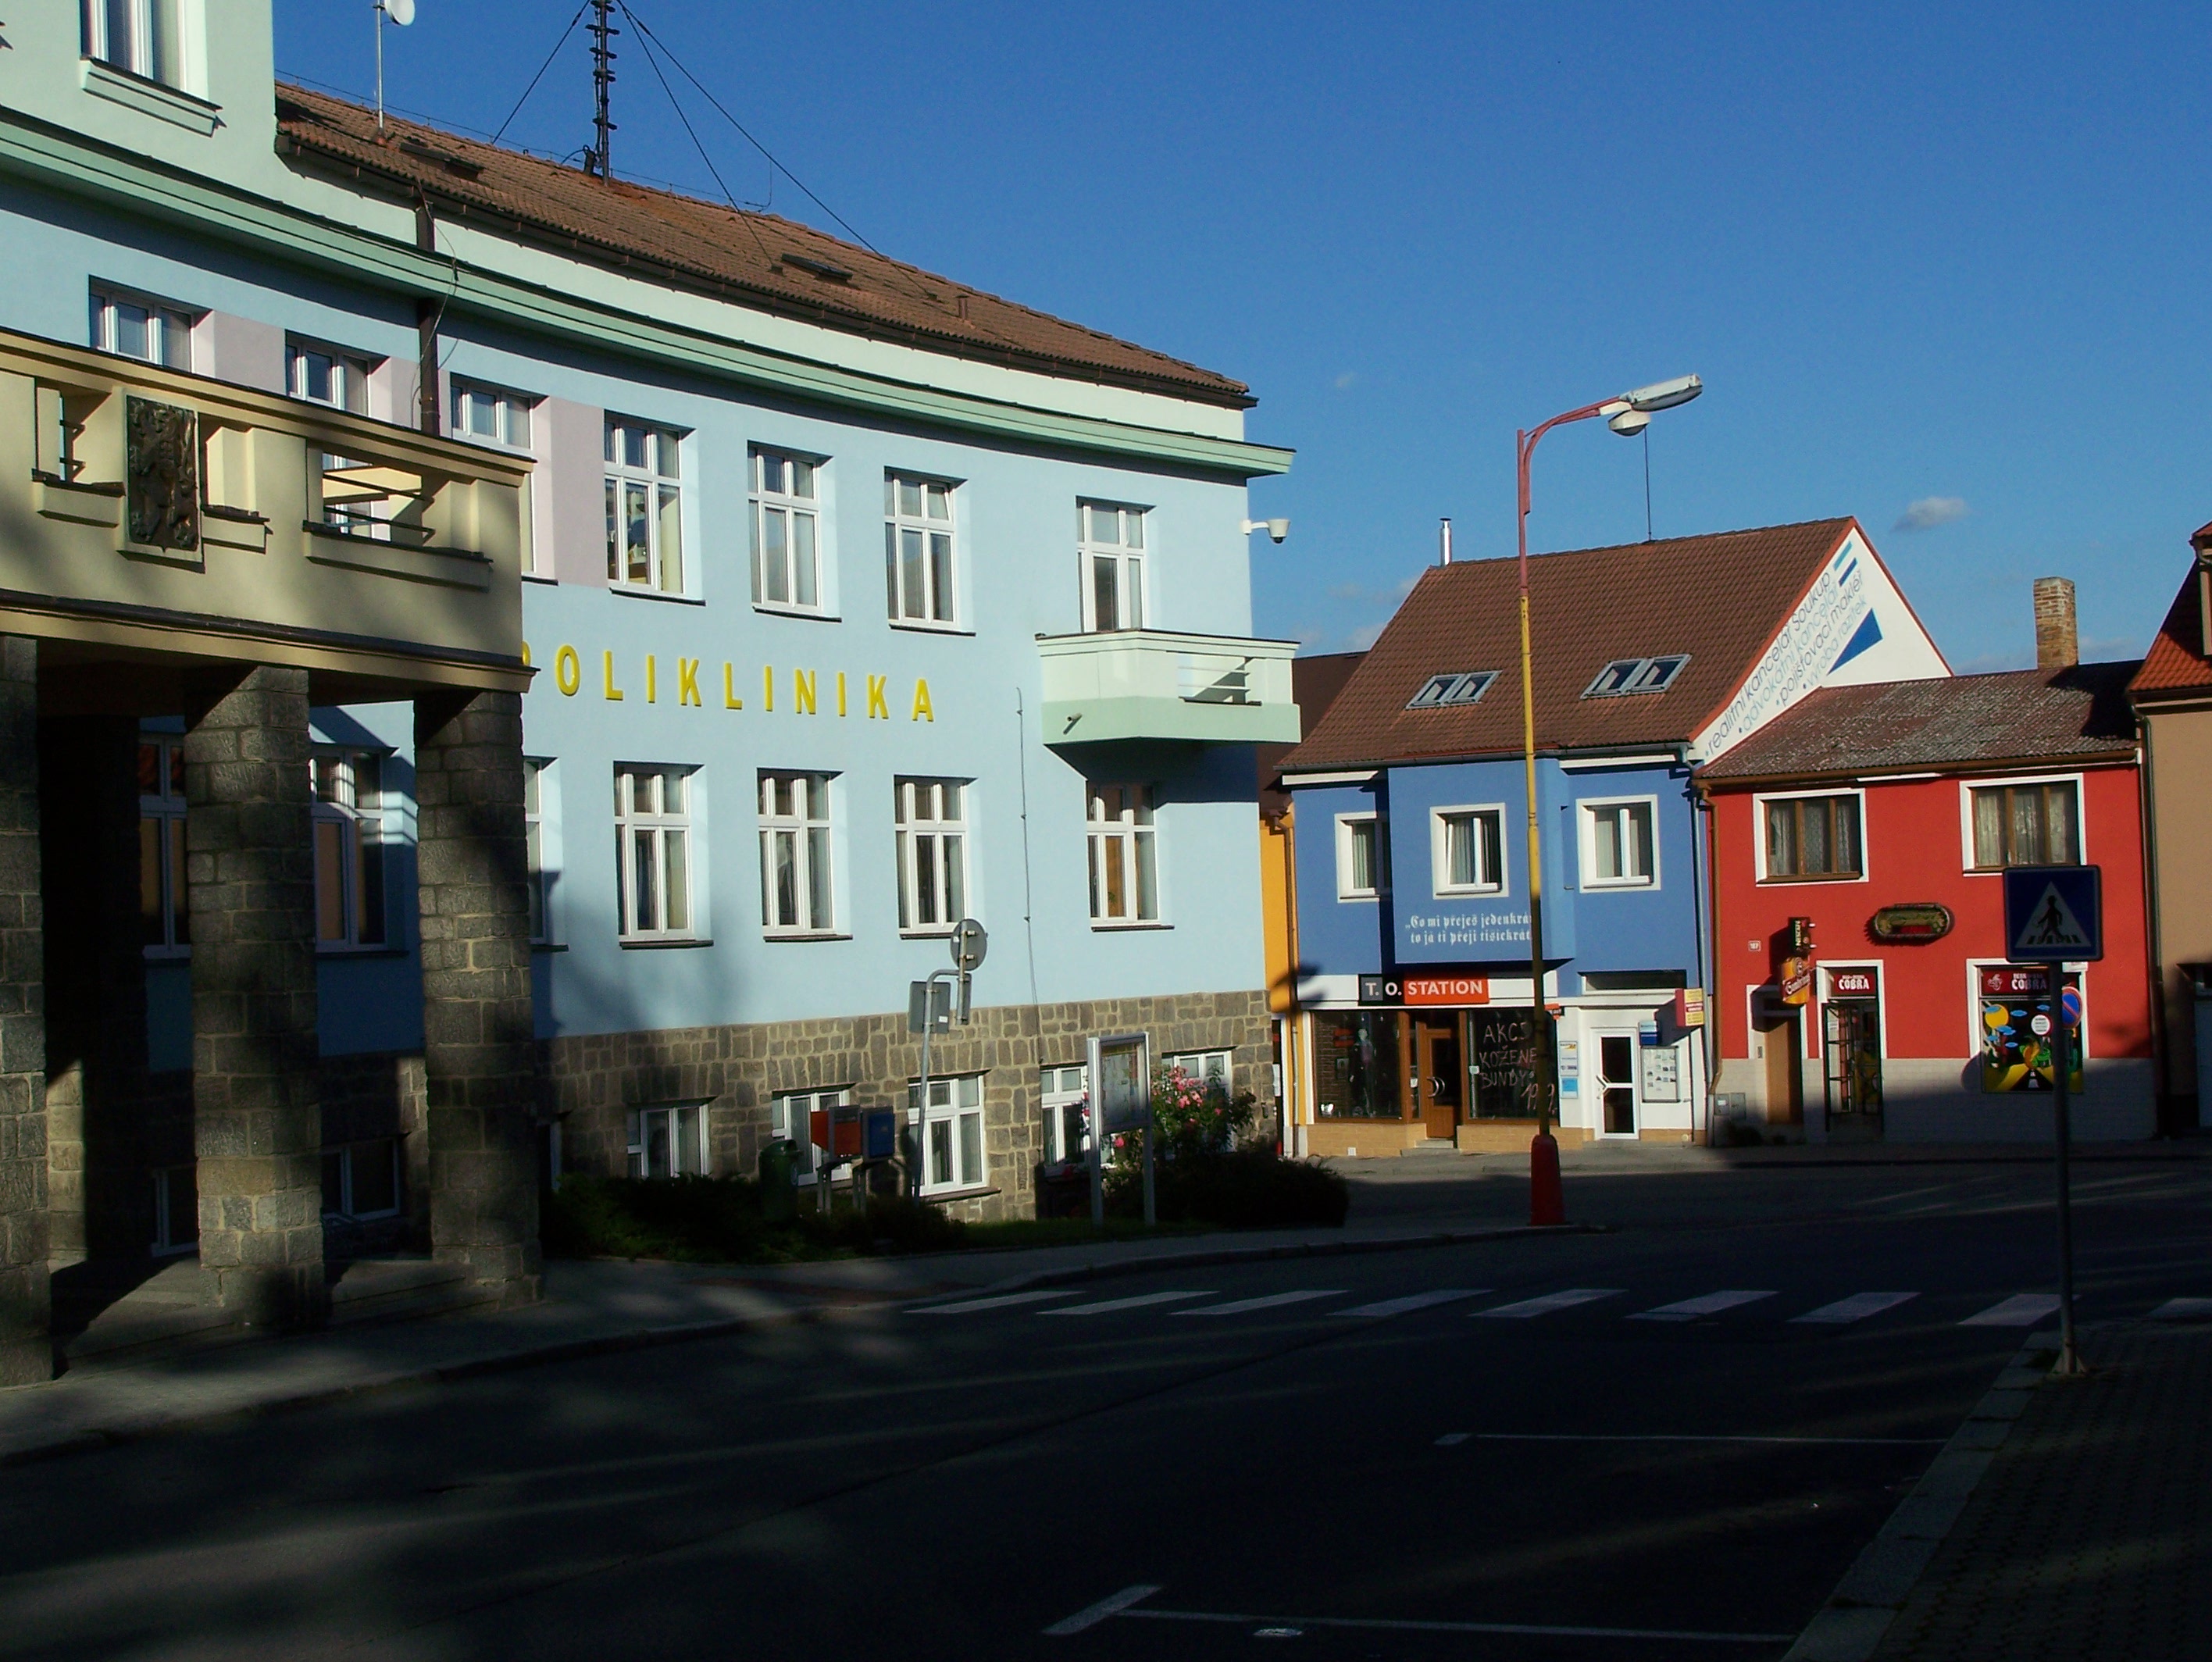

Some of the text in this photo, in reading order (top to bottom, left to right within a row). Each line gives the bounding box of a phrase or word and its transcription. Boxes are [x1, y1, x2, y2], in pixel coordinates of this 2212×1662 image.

[1481, 911, 1532, 929] jedenkrá
[1410, 932, 1421, 944] to
[1437, 930, 1447, 943] ti
[1407, 980, 1483, 996] STATION
[1838, 978, 1870, 990] COBRA
[2010, 979, 2047, 991] COBRA
